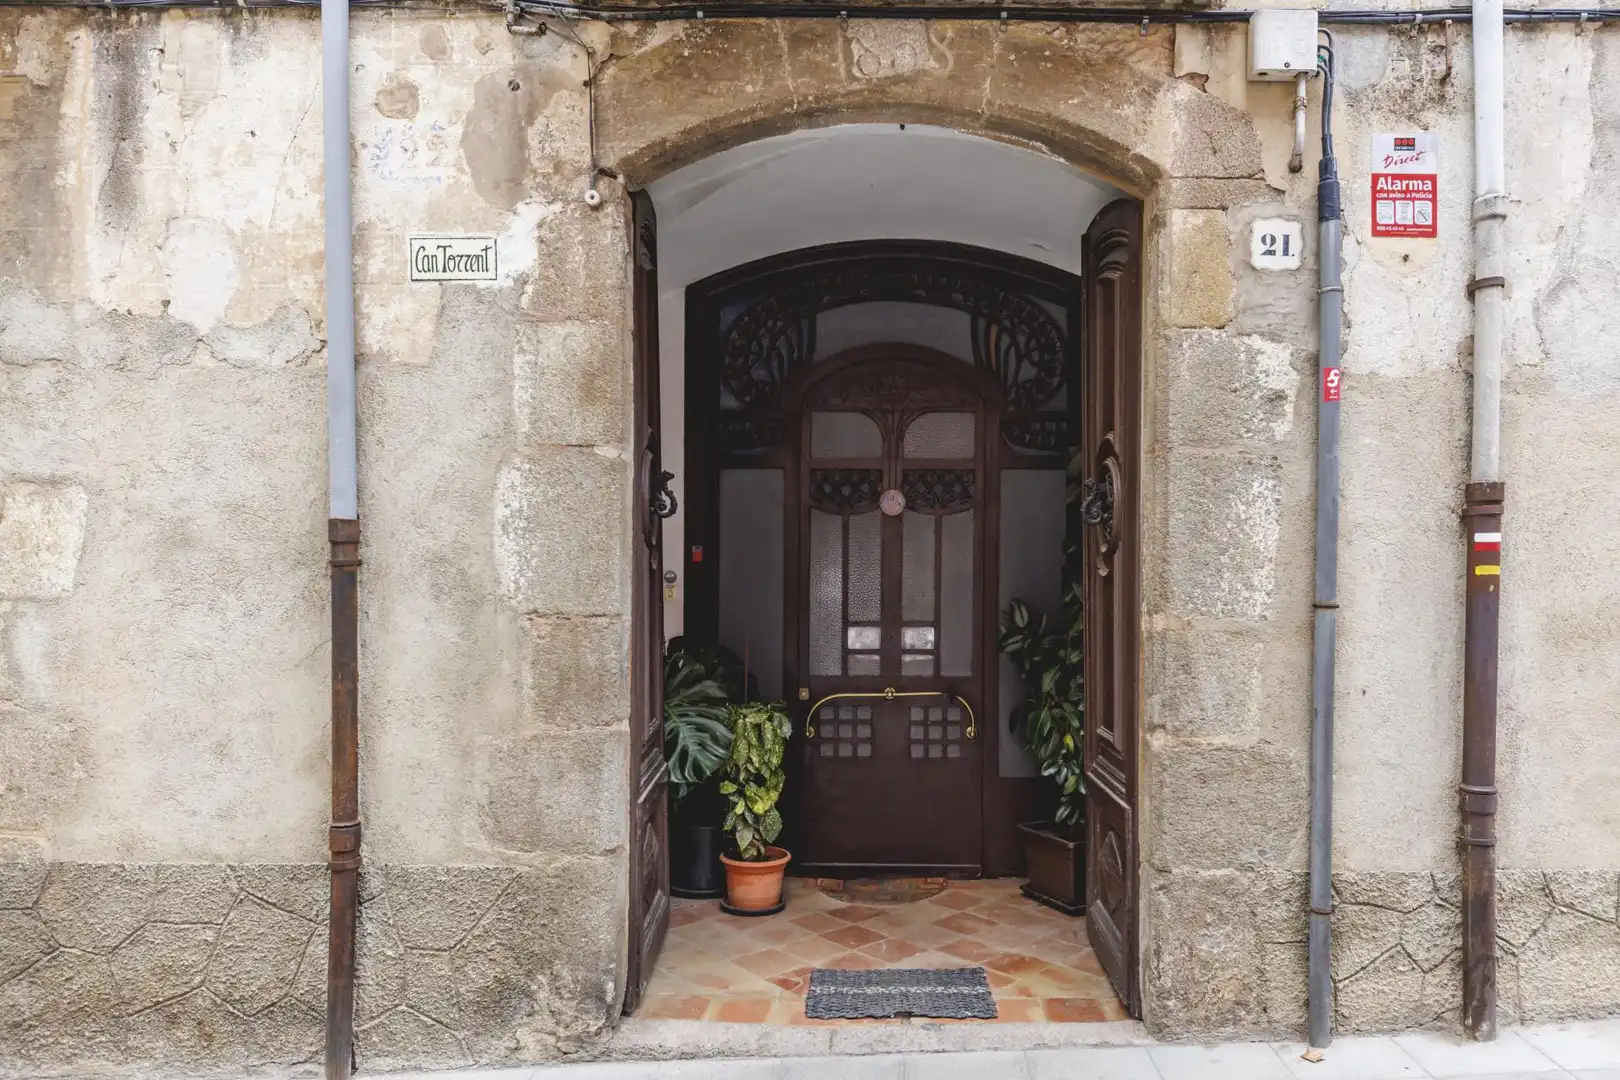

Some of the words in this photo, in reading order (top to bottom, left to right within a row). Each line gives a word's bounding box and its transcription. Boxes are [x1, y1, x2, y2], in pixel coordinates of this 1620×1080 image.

[1383, 151, 1425, 168] Direct
[1376, 176, 1433, 191] Alarma
[1389, 191, 1405, 199] aviso
[415, 245, 440, 273] Can
[436, 244, 493, 273] Torrent
